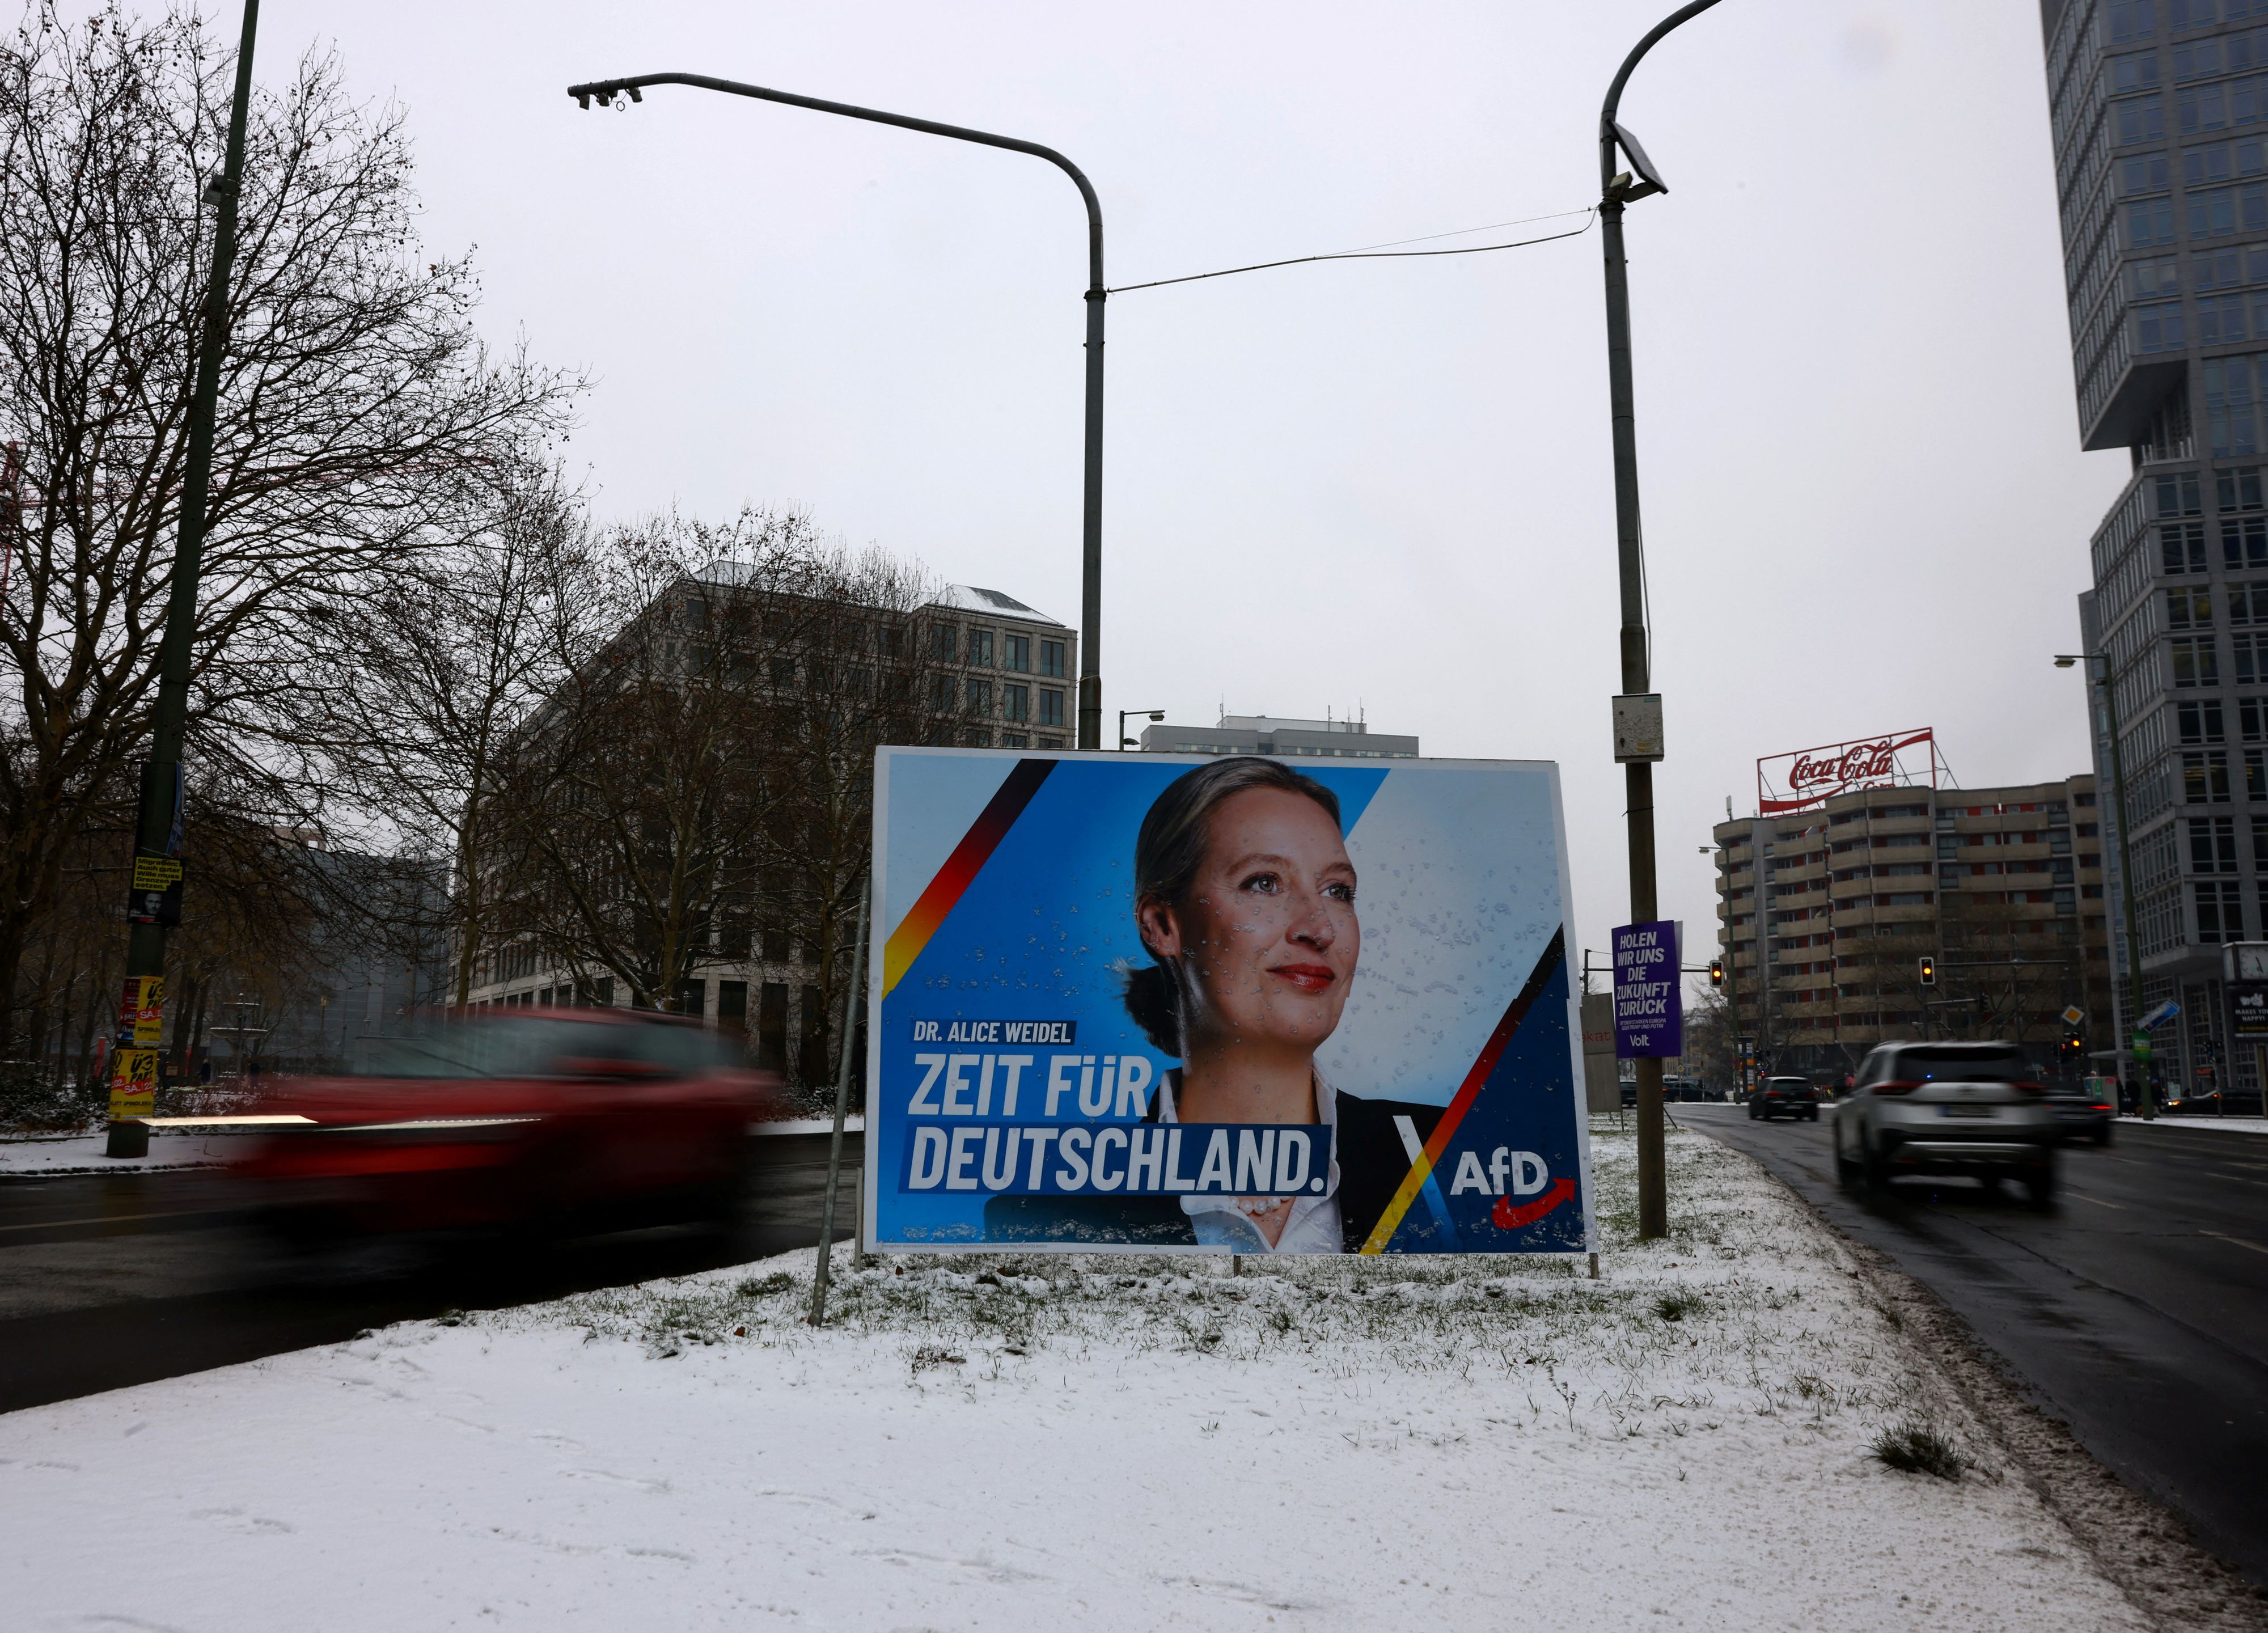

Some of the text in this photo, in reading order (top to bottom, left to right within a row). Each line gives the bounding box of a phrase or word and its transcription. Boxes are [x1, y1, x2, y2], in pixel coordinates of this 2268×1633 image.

[1789, 740, 1893, 789] Coca-Cola
[1620, 931, 1657, 950] HOLEN
[1618, 947, 1665, 967] WIR UNS
[1627, 966, 1647, 982] DIE
[1617, 982, 1671, 1000] ZUKUNFT
[1619, 997, 1667, 1017] ZURÜCK
[913, 1022, 1072, 1043] DR. ALICE WEIDEL
[1630, 1034, 1650, 1047] Volt
[907, 1053, 1153, 1117] ZEIT FÜR
[907, 1126, 1325, 1192] DEUTSCHLAND.
[1450, 1146, 1548, 1195] AfD
